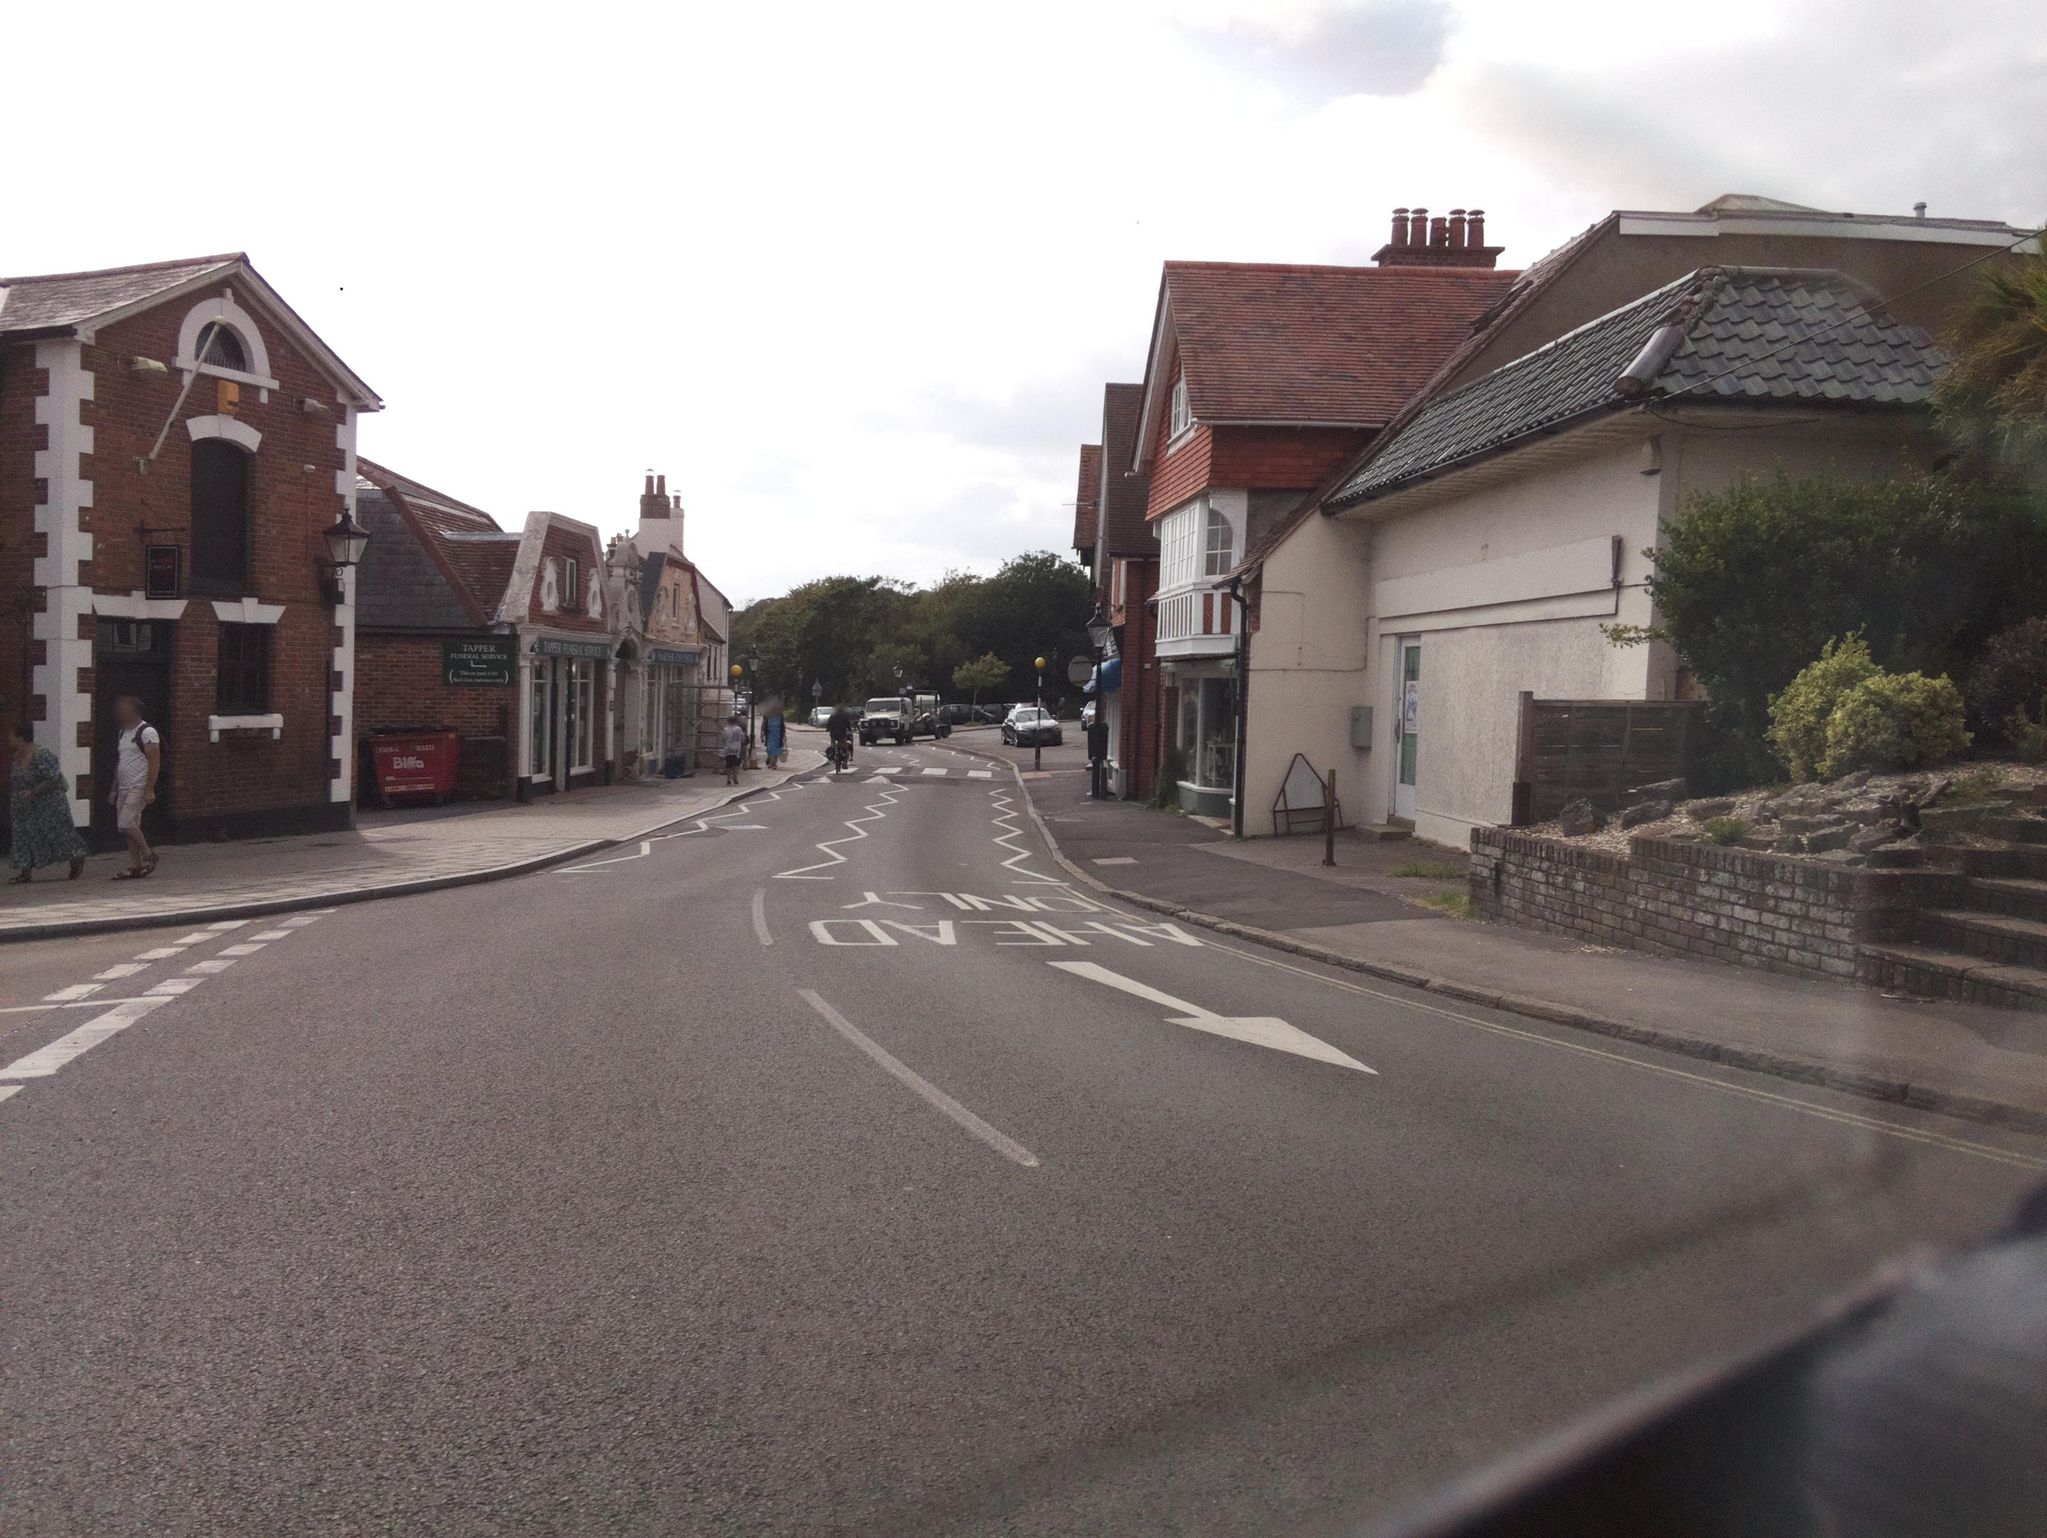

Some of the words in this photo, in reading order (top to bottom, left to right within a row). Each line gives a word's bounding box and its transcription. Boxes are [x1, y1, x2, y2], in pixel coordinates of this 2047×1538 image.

[462, 644, 496, 653] TAPPER
[450, 652, 479, 660] FUNERAL
[481, 653, 507, 661] SERVICE
[393, 755, 424, 769] Biffa
[808, 919, 1205, 946] AHEAD
